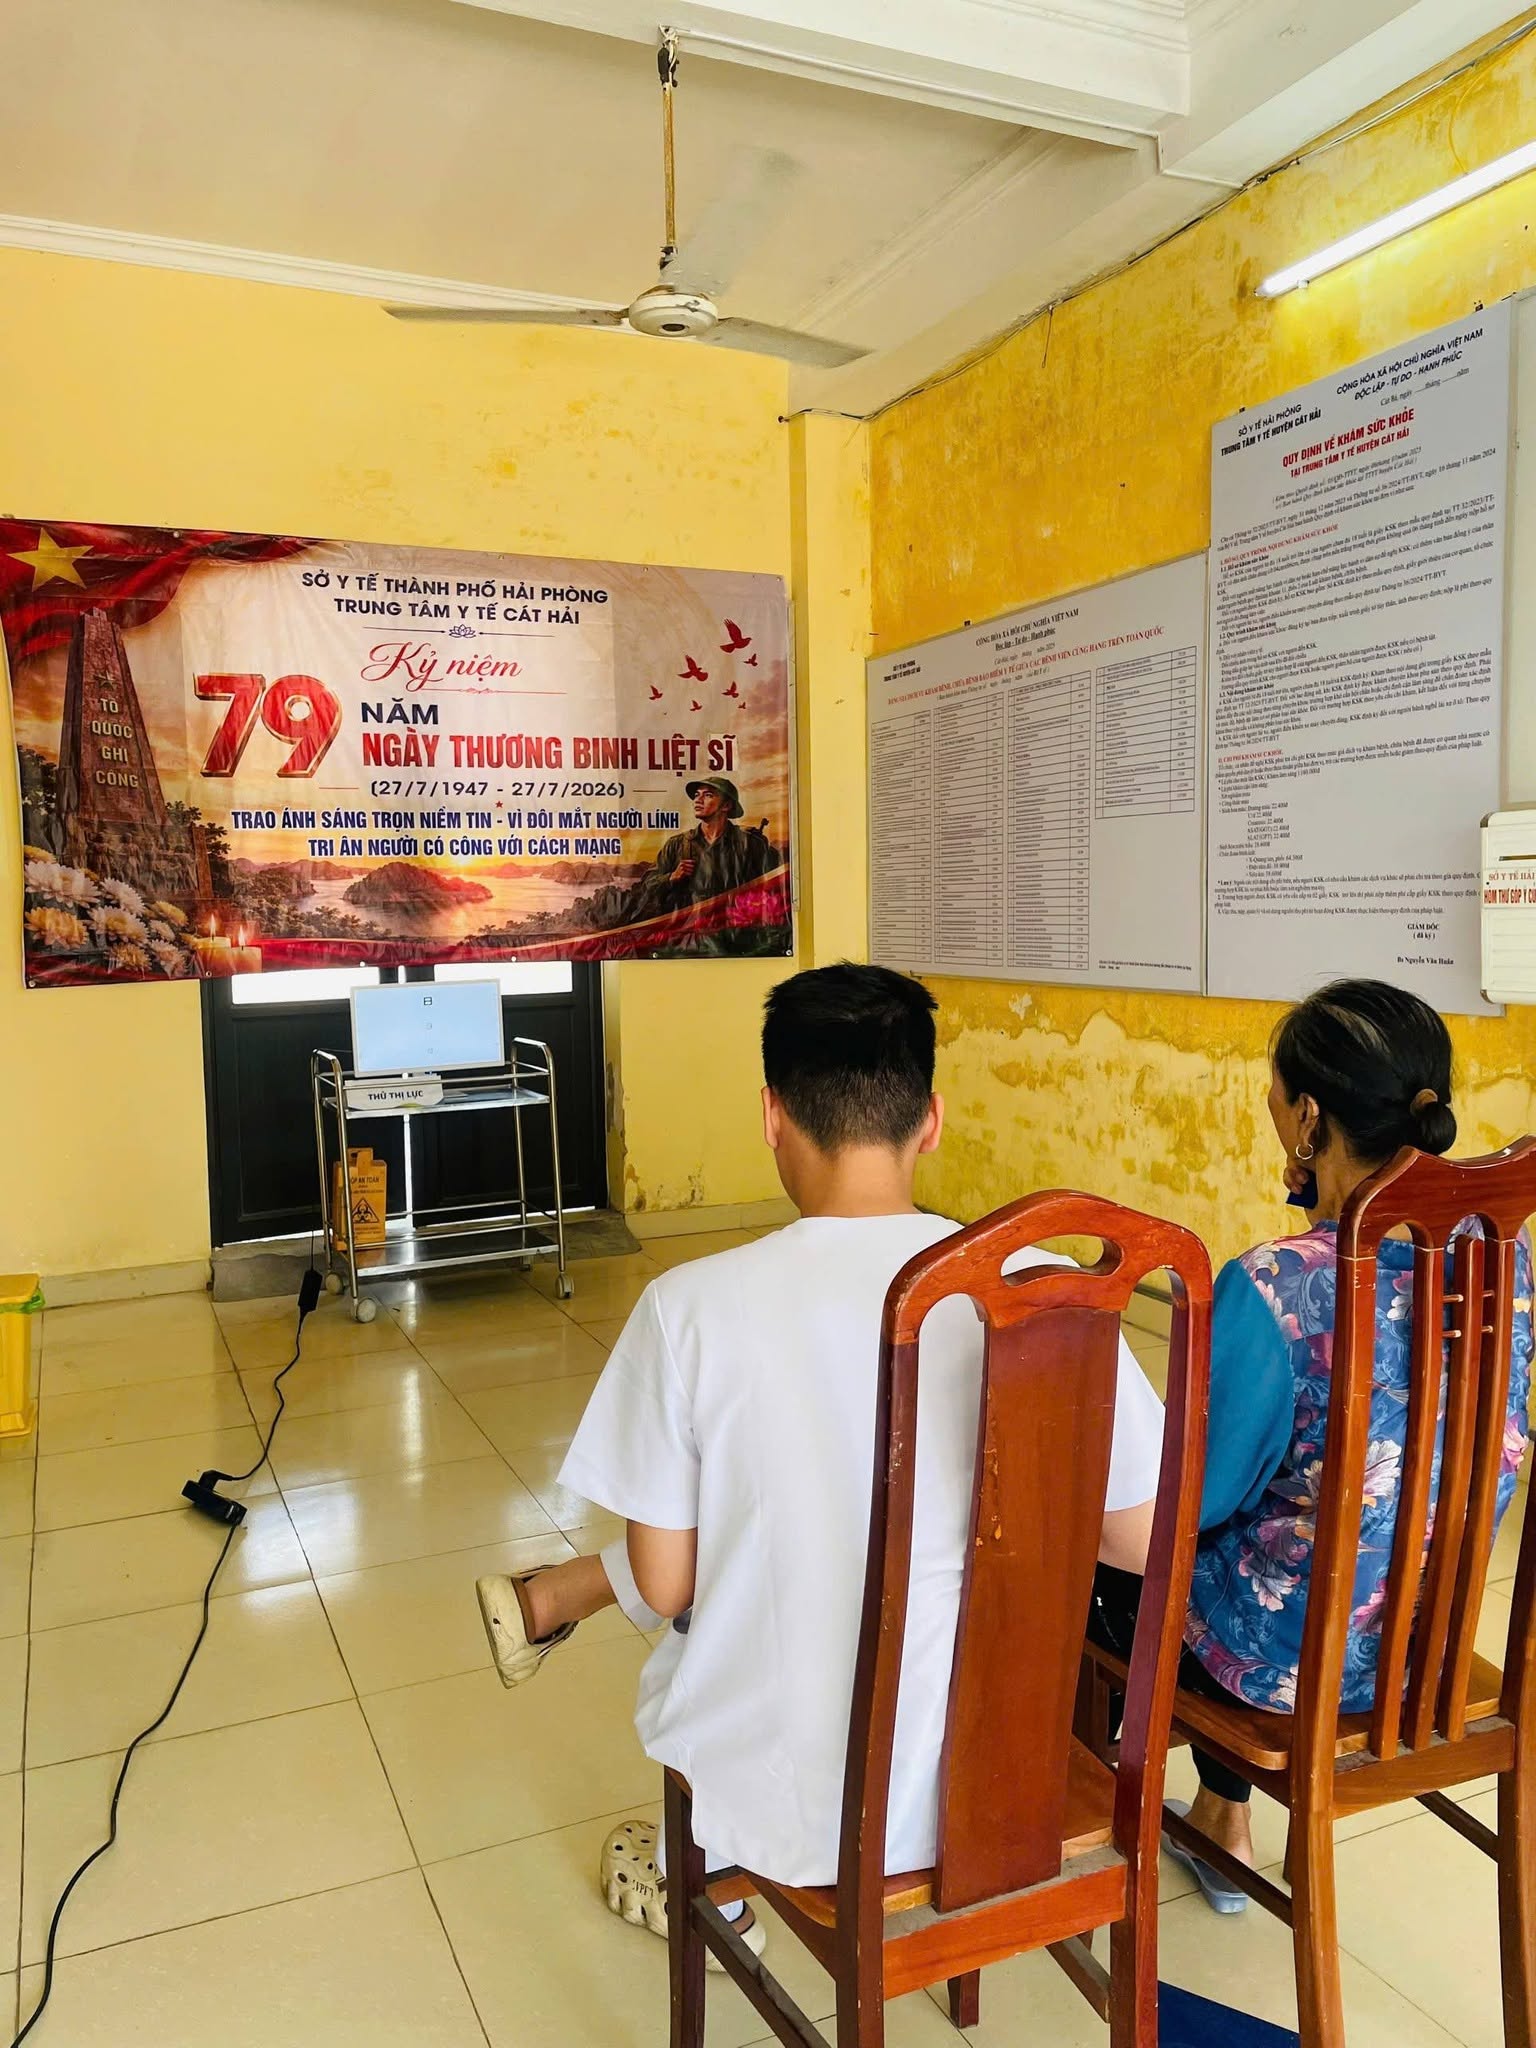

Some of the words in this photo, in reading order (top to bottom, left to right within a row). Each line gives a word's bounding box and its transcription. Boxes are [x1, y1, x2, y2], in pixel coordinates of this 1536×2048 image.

[1336, 379, 1358, 395] CỘNG
[1389, 361, 1402, 373] HỘI
[1447, 336, 1462, 350] VIỆT
[1463, 328, 1483, 343] NAM
[1401, 371, 1412, 383] DO
[1221, 442, 1241, 456] TRUNG
[1257, 434, 1261, 443] Y
[1272, 421, 1293, 437] HUYỆN
[1309, 407, 1321, 422] HẢI
[1249, 424, 1254, 432] Y
[1276, 404, 1301, 421] PHÒNG
[1282, 451, 1299, 468] QUY
[1301, 443, 1322, 461] ĐỊNH
[1302, 459, 1324, 475] TRUNG
[1341, 451, 1345, 461] Y
[1356, 438, 1380, 455] HUYỆN
[1396, 427, 1410, 441] HẢI
[302, 569, 330, 588] SỞ
[336, 575, 349, 590] Y
[355, 572, 380, 592] TẾ
[384, 577, 450, 596] THÀNH
[456, 579, 496, 598] PHỐ
[502, 581, 535, 600] HẢI
[541, 585, 609, 604] PHÒNG
[334, 598, 402, 616] TRUNG
[408, 600, 450, 619] TÂM
[457, 605, 469, 619] Y
[476, 602, 499, 621] TẾ
[503, 605, 542, 623] CÁT
[547, 606, 580, 625] HẢI
[360, 641, 444, 693] Kỷ
[445, 653, 523, 682] niệm
[192, 671, 343, 779] 79
[361, 698, 439, 725] NĂM
[101, 745, 128, 763] GHI
[362, 726, 440, 769] NGÀY
[449, 733, 563, 771] THƯƠNG
[572, 736, 638, 770] BINH
[648, 733, 700, 777] LIỆT
[707, 734, 737, 772] SĨ
[370, 780, 489, 798] (27/7/1947
[511, 782, 625, 799] 27/7/2026)
[231, 811, 276, 830] TRAO
[281, 807, 316, 830] ÁNH
[321, 806, 367, 830] SÁNG
[372, 811, 415, 833] TRỌN
[420, 806, 462, 830] NIỀM
[467, 811, 492, 830] TIN
[507, 808, 523, 829] VÌ
[527, 809, 553, 829] ĐÔI
[558, 807, 592, 829] MẮT
[596, 808, 643, 829] NGƯỜI
[647, 806, 680, 829] LÍNH
[308, 839, 334, 856] TRI
[339, 835, 364, 856] ÂN
[368, 836, 419, 856] NGƯỜI
[423, 836, 445, 856] CÓ
[449, 835, 493, 856] CÔNG
[498, 835, 523, 856] VỚI
[528, 835, 570, 856] CÁCH
[575, 838, 621, 859] MẠNG
[1501, 872, 1507, 881] Y
[388, 1092, 405, 1101] THỊ
[406, 1090, 424, 1100] LỰC
